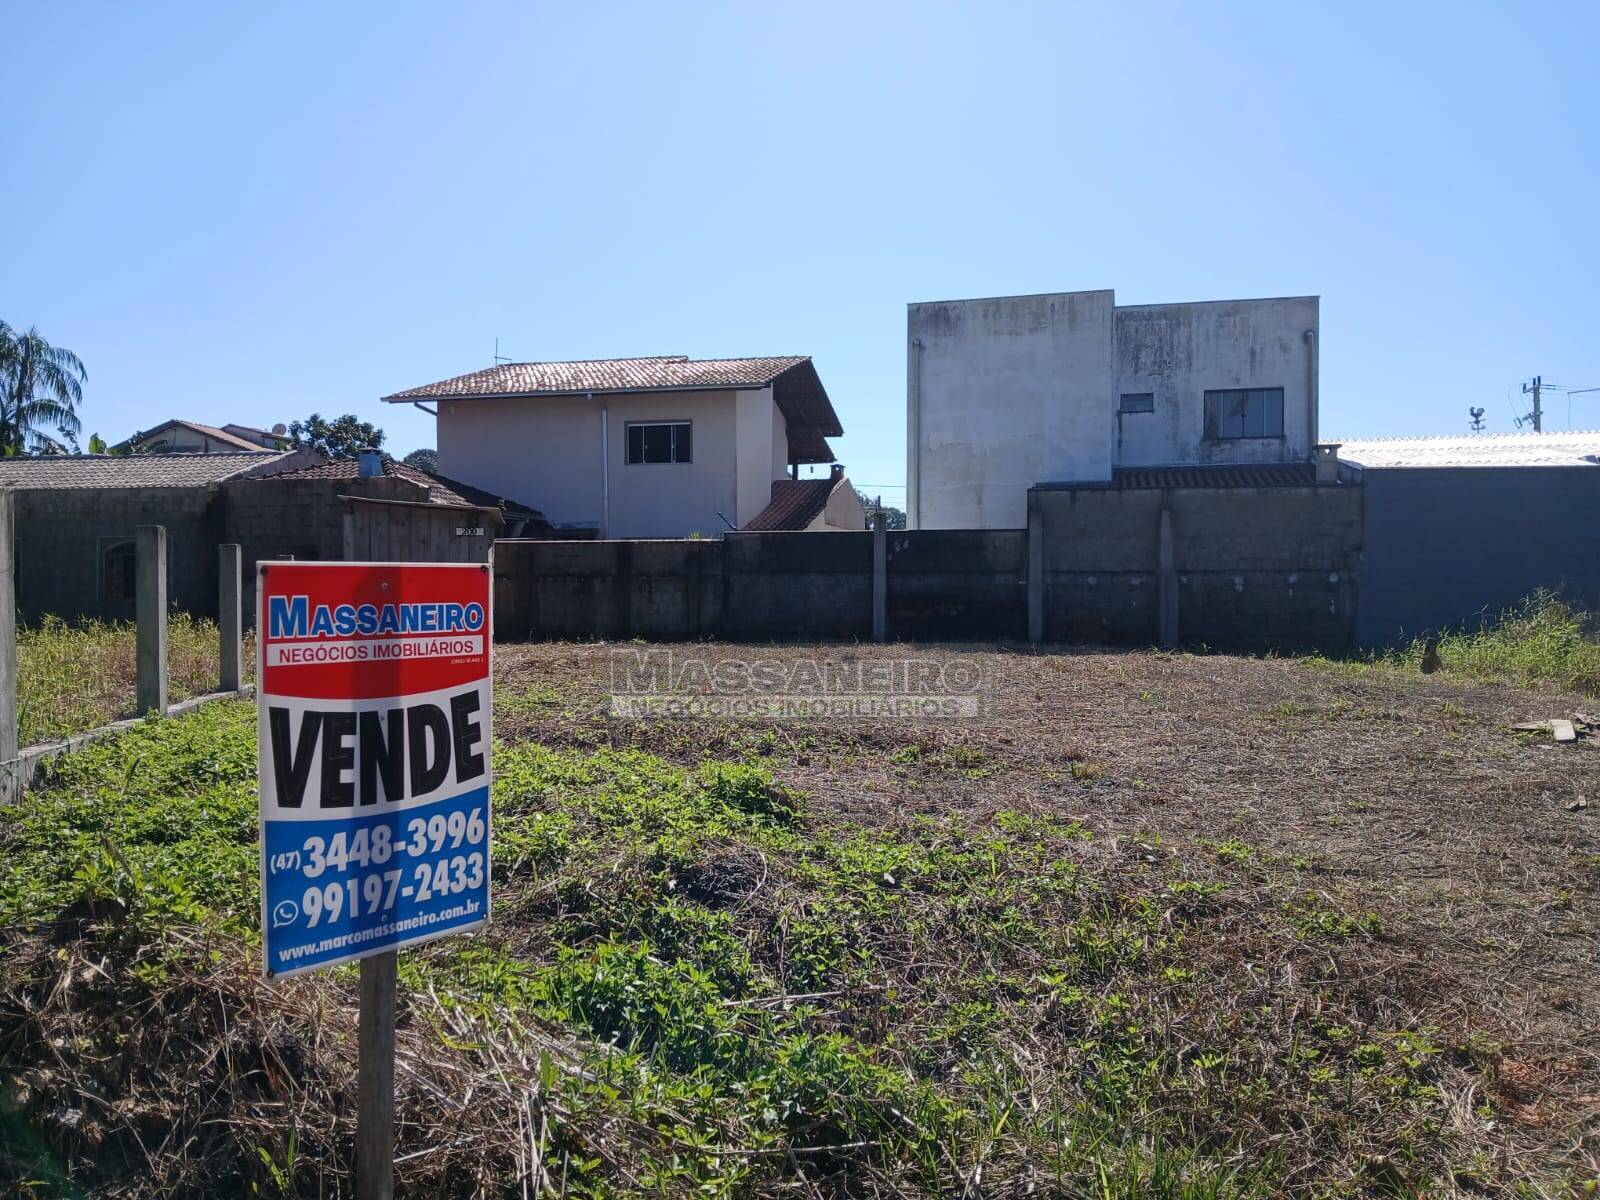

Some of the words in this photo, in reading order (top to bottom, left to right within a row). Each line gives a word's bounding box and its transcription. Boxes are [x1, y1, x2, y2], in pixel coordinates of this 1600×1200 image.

[268, 595, 484, 640] MASSANEIRO
[279, 644, 368, 664] NEGÓCIOS
[373, 640, 474, 659] IMOBILIÁRIOS
[269, 690, 485, 808] VENDE
[270, 852, 300, 875] (47)
[302, 808, 485, 878] 3448-3996
[302, 852, 484, 928] 99197-2433
[279, 900, 479, 962] www.marcomassaneiro.com.br
